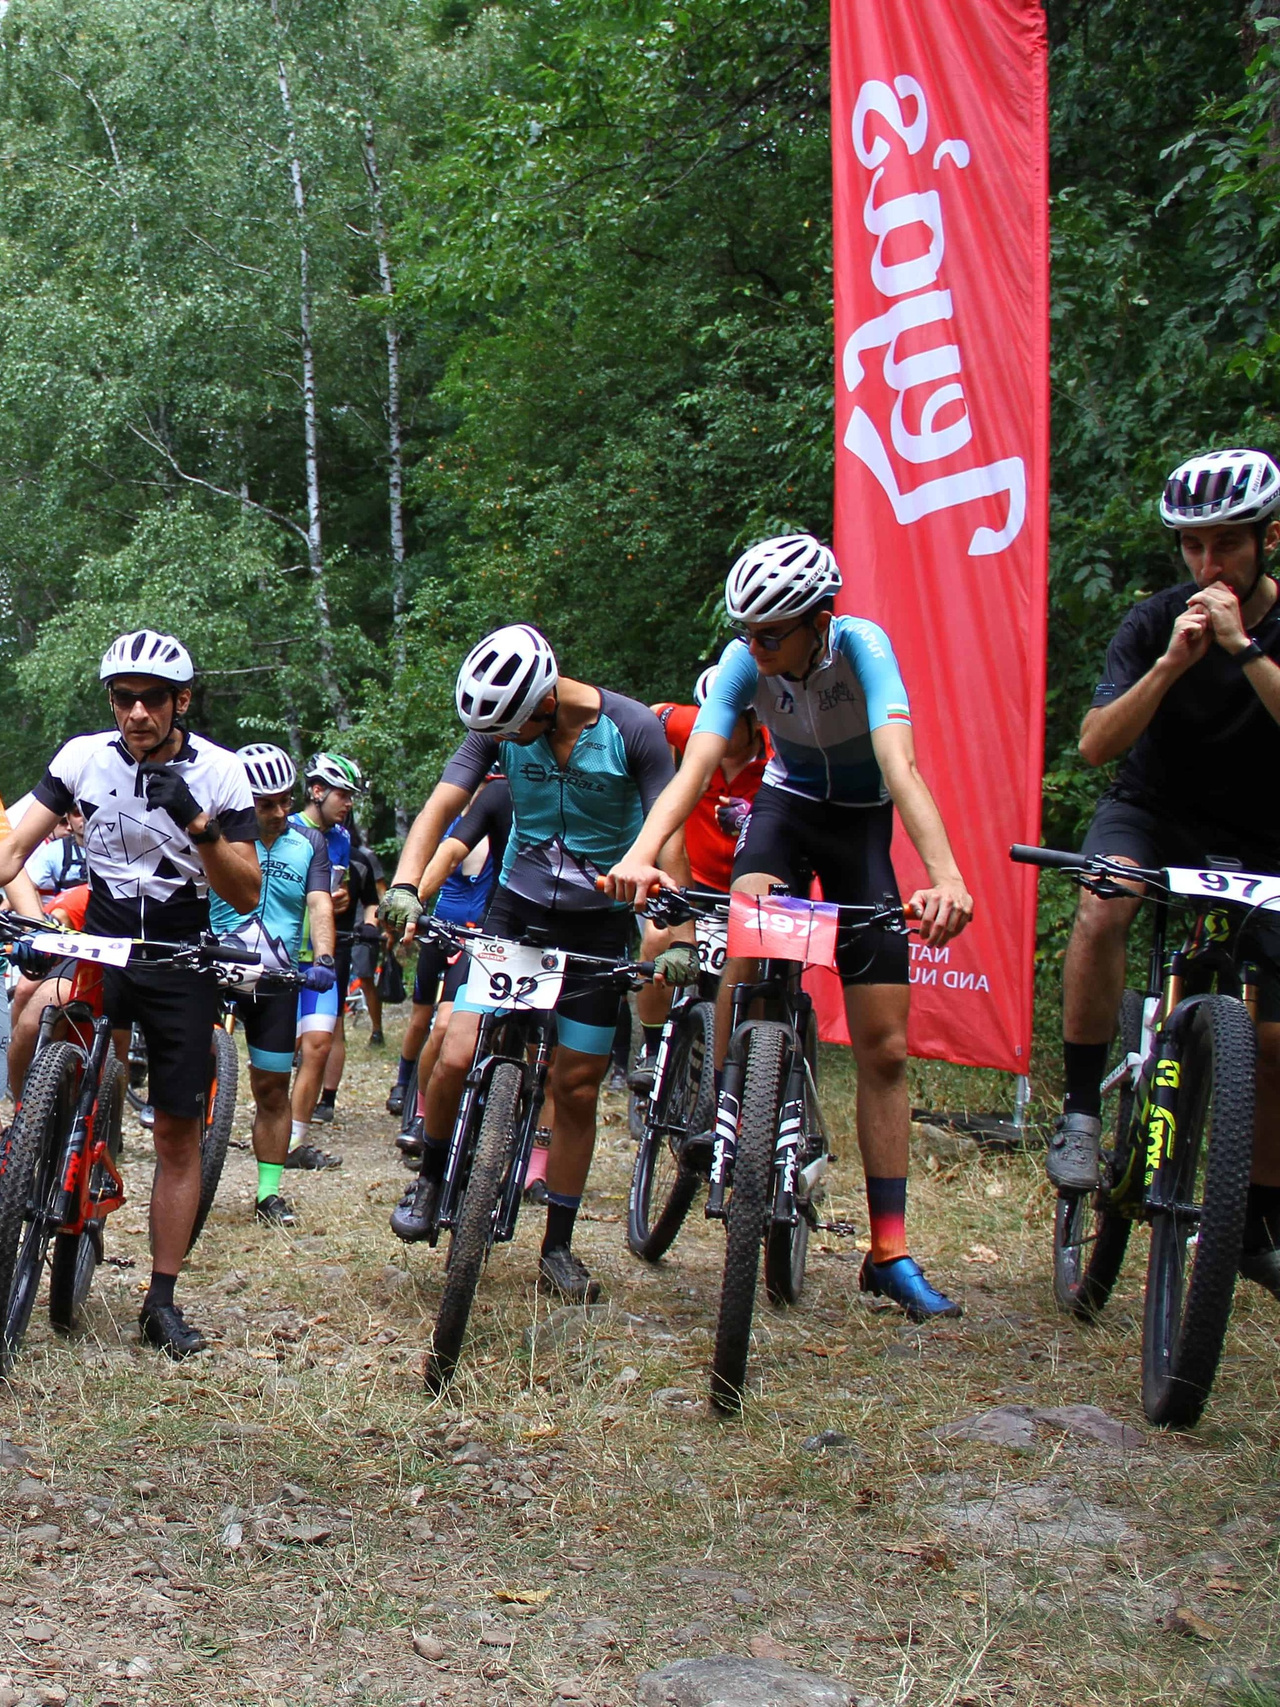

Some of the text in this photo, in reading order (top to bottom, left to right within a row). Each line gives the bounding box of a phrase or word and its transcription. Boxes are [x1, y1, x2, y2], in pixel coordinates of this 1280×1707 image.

[1263, 488, 1280, 505] SCO
[1198, 873, 1262, 898] 97
[744, 908, 820, 937] 297
[57, 942, 102, 958] 91
[697, 941, 728, 970] 60
[488, 972, 539, 1003] 92
[1146, 1119, 1164, 1170] FOX
